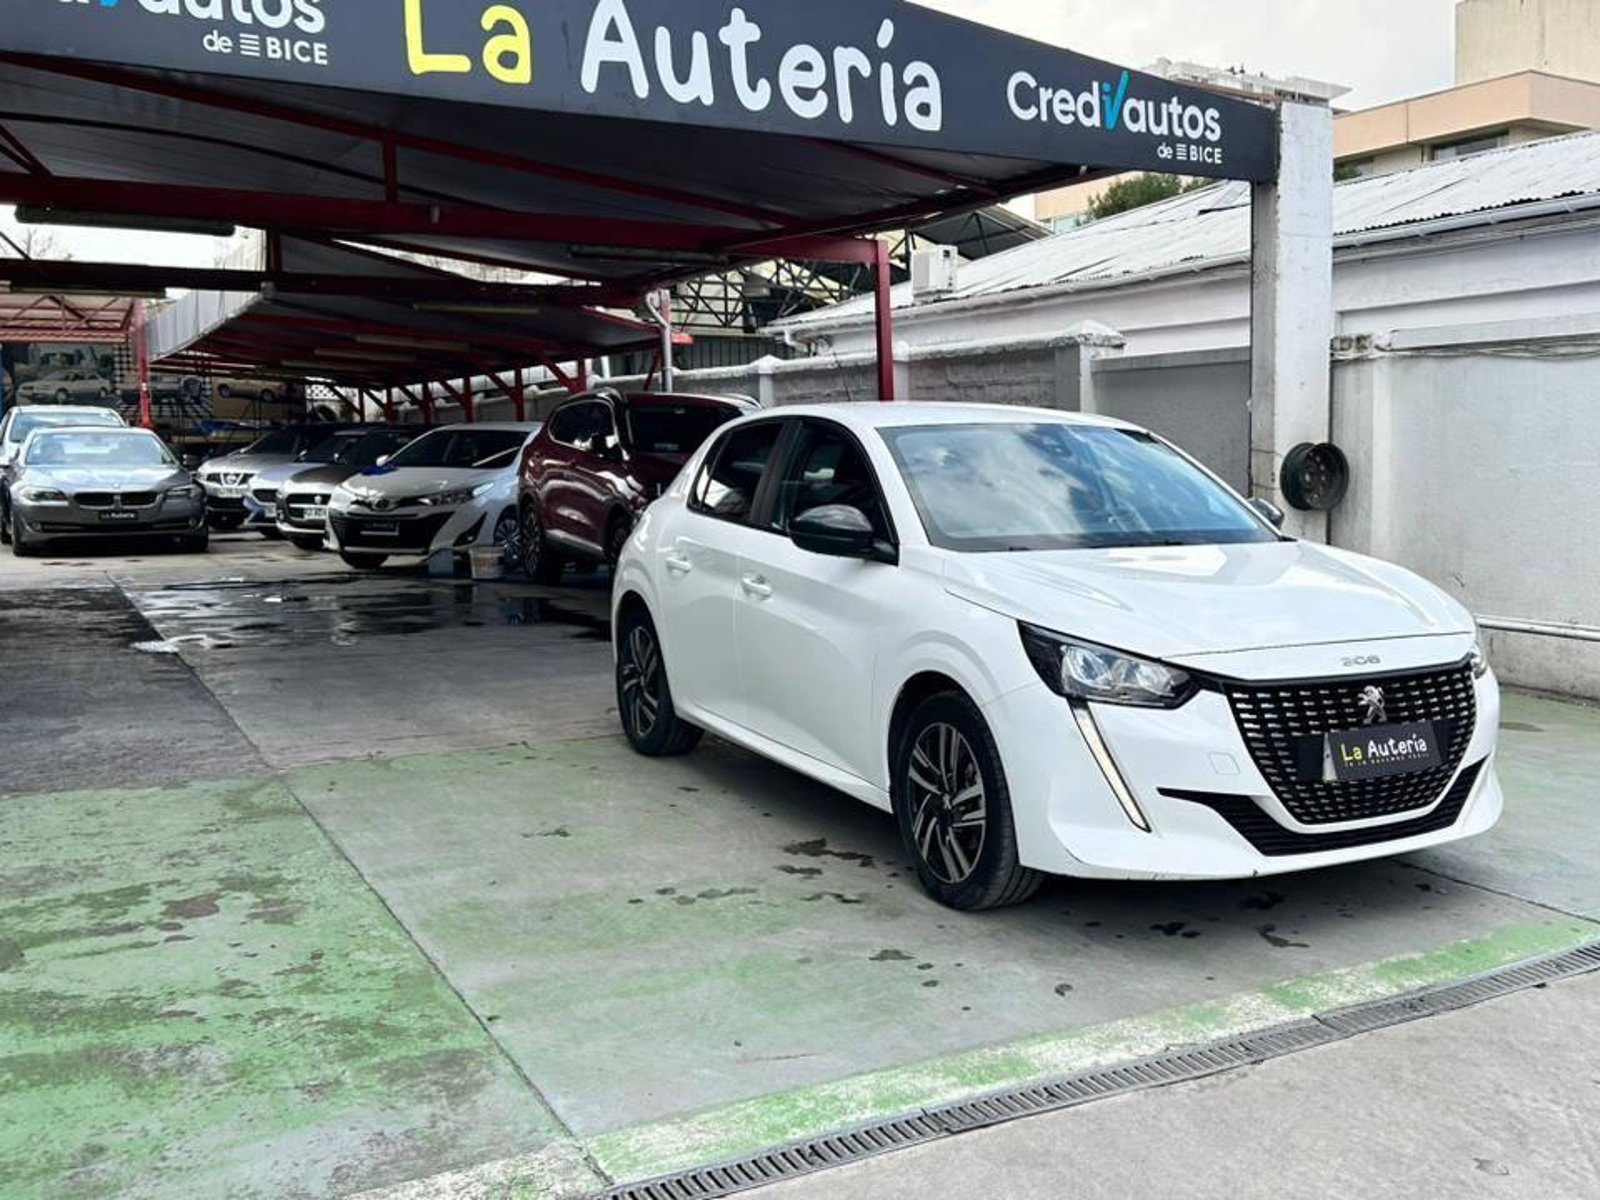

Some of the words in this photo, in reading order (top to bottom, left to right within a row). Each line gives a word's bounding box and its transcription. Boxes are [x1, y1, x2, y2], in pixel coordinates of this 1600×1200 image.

[202, 30, 233, 53] de
[265, 36, 329, 65] BICE
[405, 0, 532, 85] La
[580, 0, 943, 132] Autería
[1157, 142, 1174, 160] de
[1189, 145, 1223, 164] BICE
[1340, 743, 1363, 761] La
